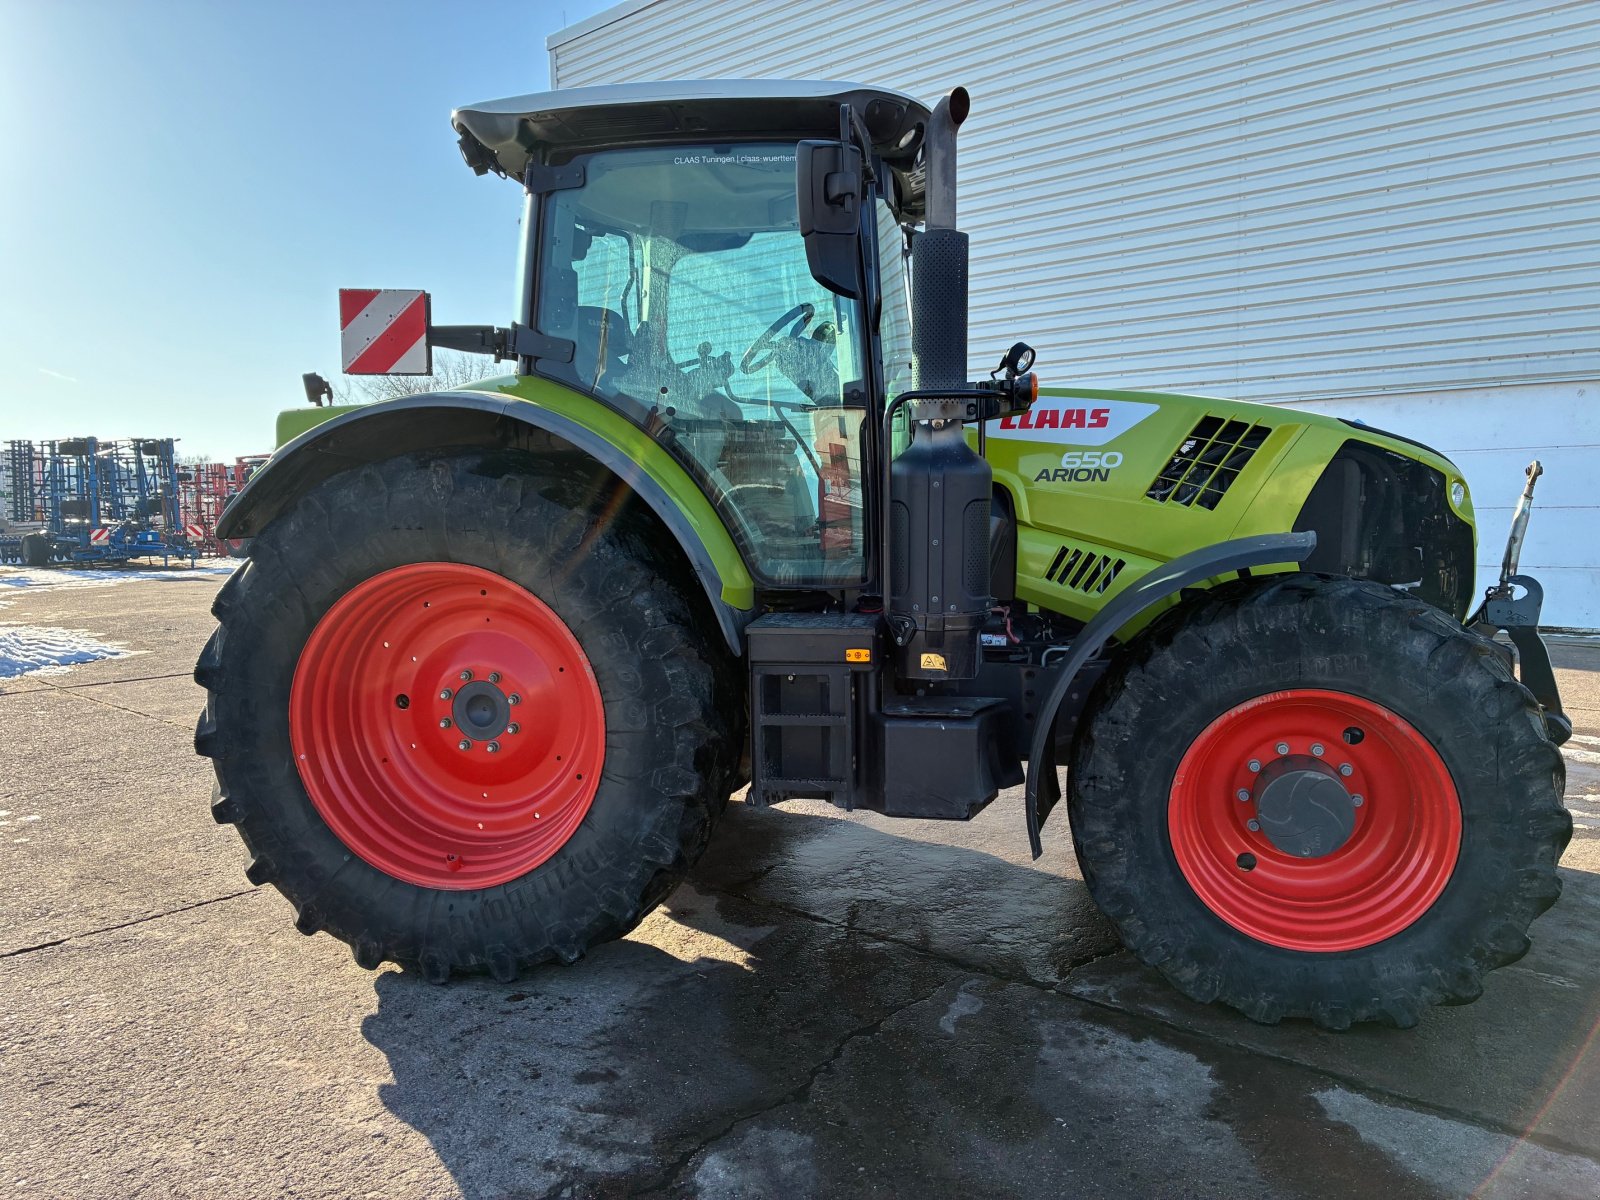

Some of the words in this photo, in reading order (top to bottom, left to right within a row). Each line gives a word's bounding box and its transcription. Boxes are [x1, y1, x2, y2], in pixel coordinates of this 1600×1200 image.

[674, 155, 700, 165] CLAAS
[701, 154, 735, 164] Tuningen
[999, 409, 1110, 430] CLAAS
[1060, 451, 1124, 469] 650
[1033, 468, 1111, 483] ARION
